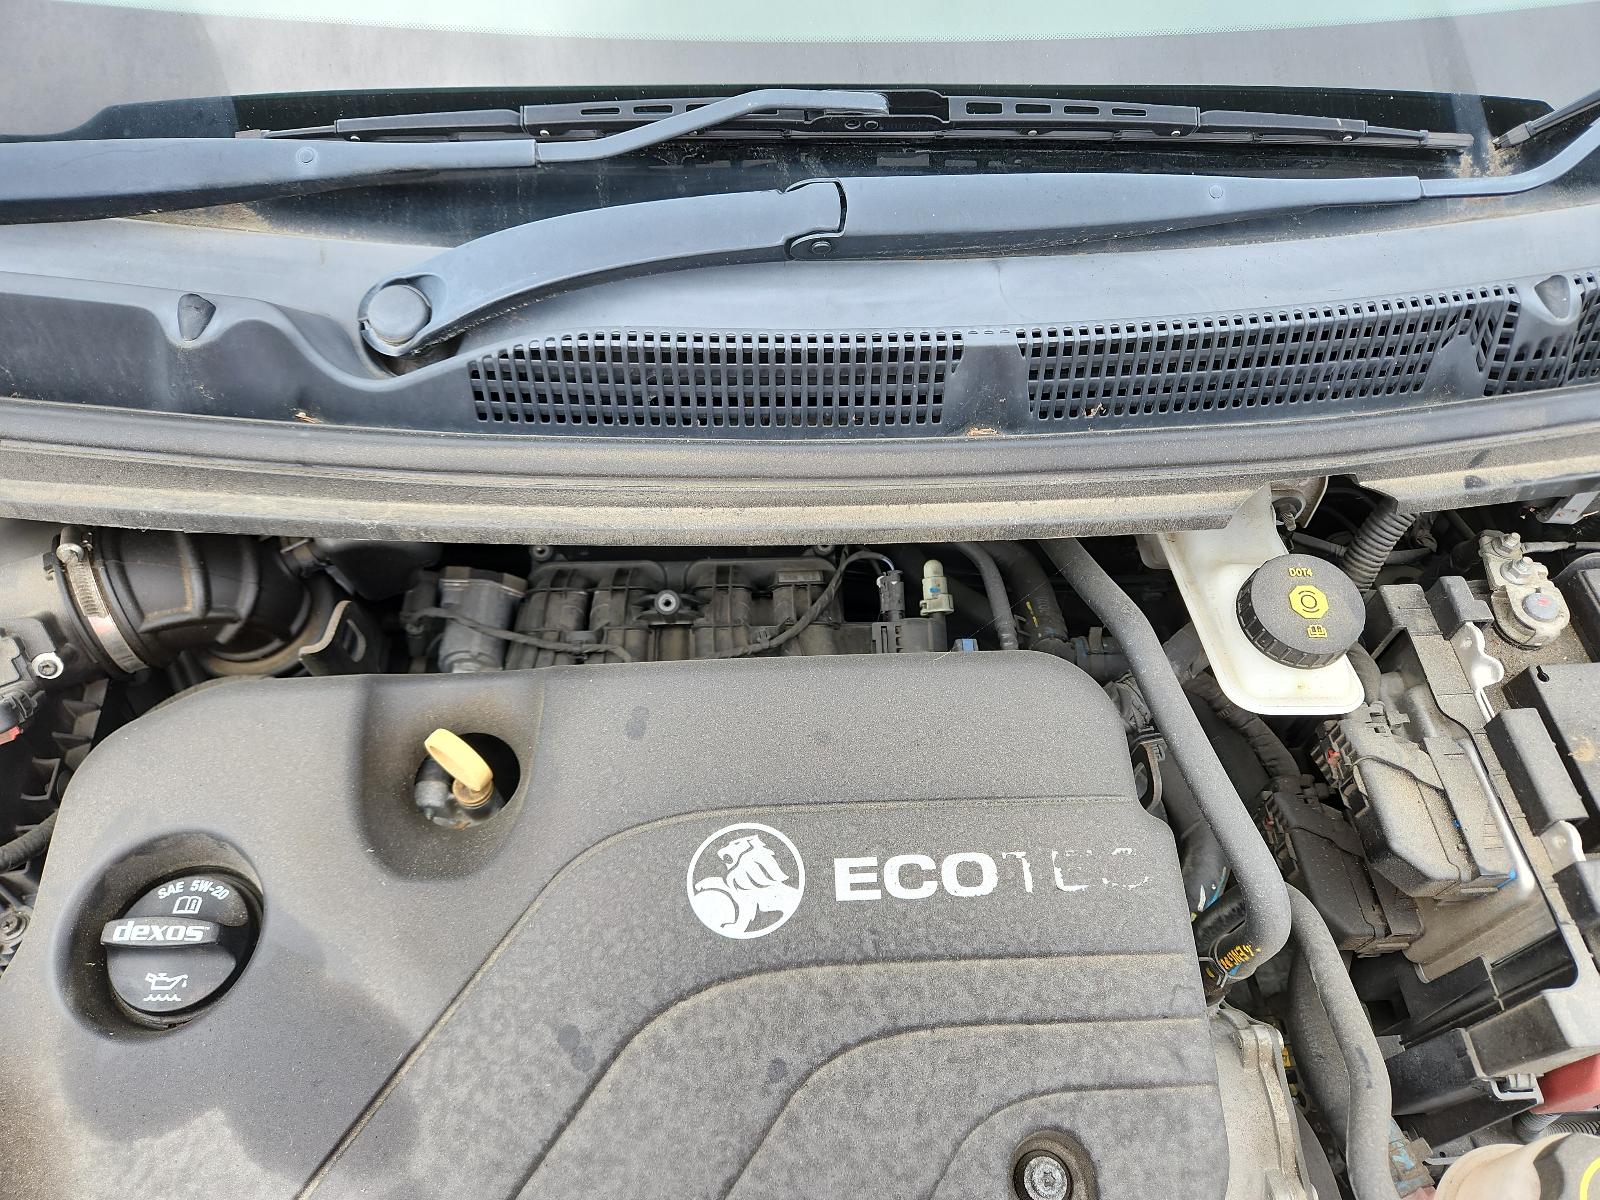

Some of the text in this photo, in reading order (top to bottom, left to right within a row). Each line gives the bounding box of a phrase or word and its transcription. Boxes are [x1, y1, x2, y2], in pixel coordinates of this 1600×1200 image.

[1288, 567, 1313, 577] DOT4
[157, 879, 229, 900] SAE 5W-20
